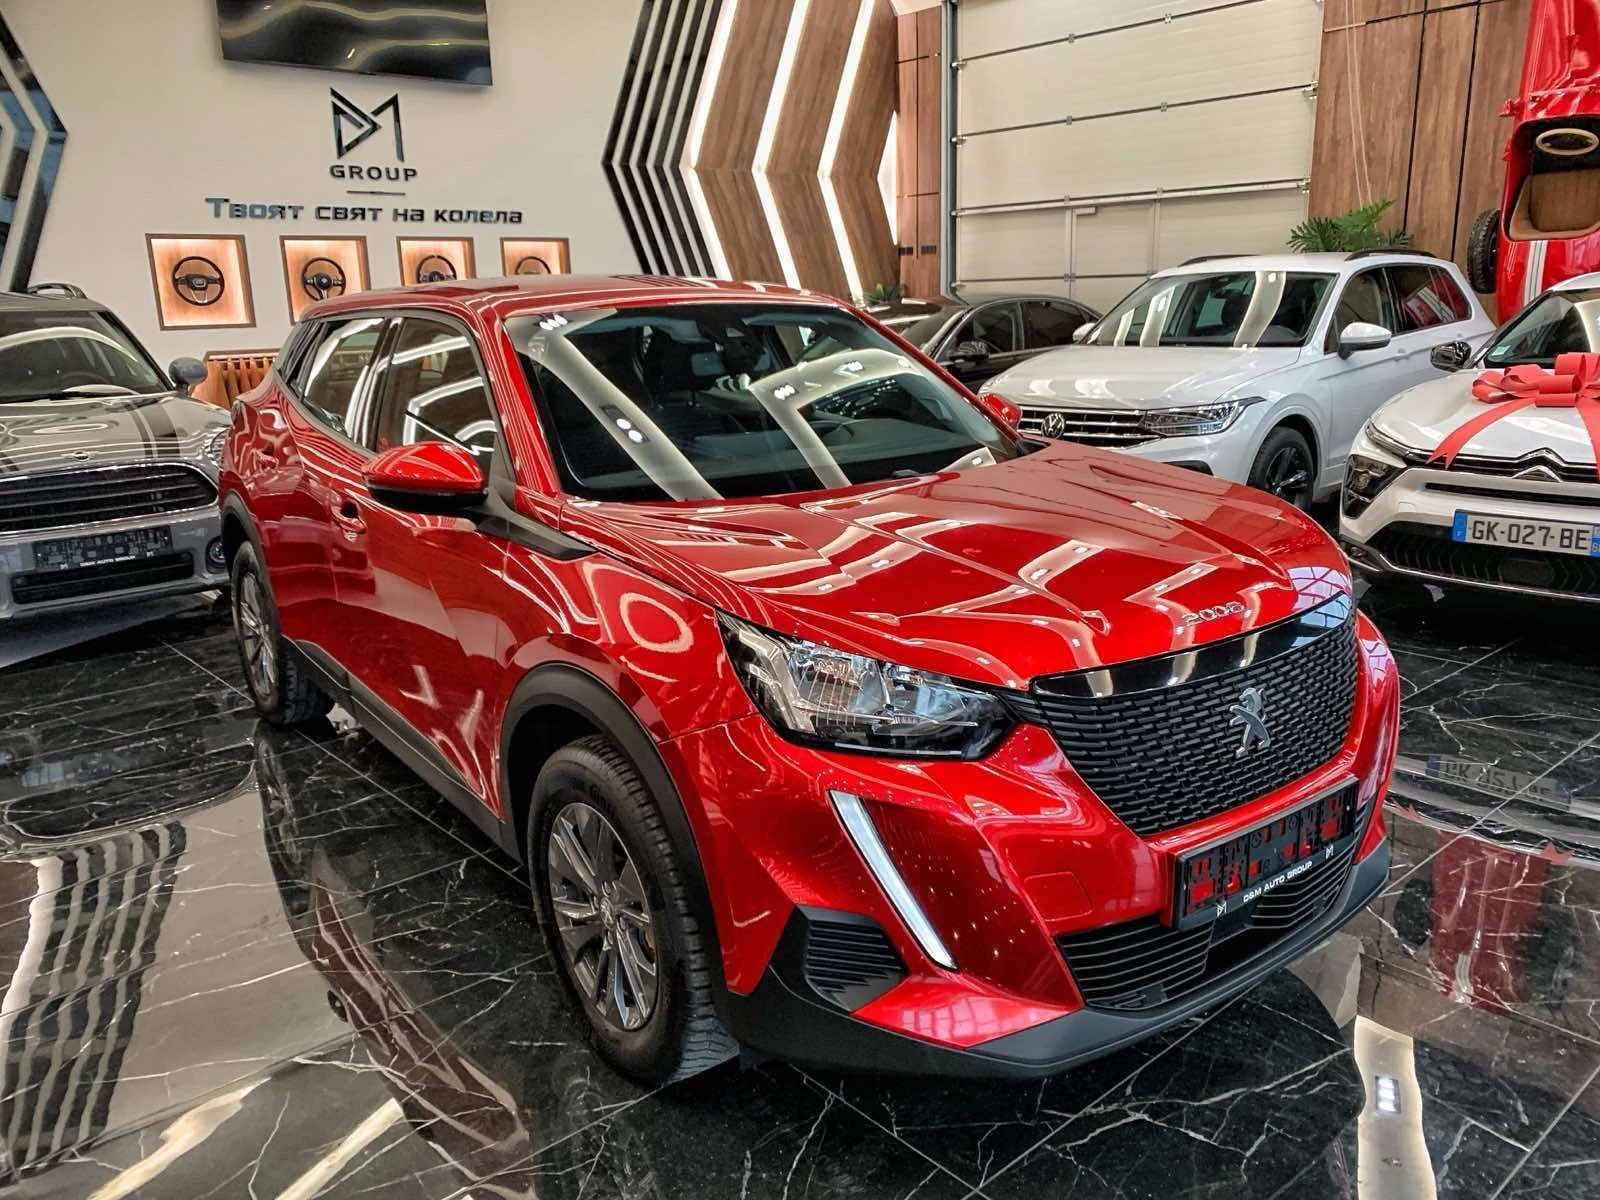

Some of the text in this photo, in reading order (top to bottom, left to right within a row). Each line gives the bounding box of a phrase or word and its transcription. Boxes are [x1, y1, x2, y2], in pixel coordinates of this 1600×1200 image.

[329, 164, 418, 182] GROUP
[205, 198, 523, 224] Твоят свят на колела
[1471, 520, 1590, 550] GK-027-BE
[1182, 601, 1245, 626] 2008
[1263, 875, 1285, 892] AUTO
[1286, 861, 1313, 879] GROUP
